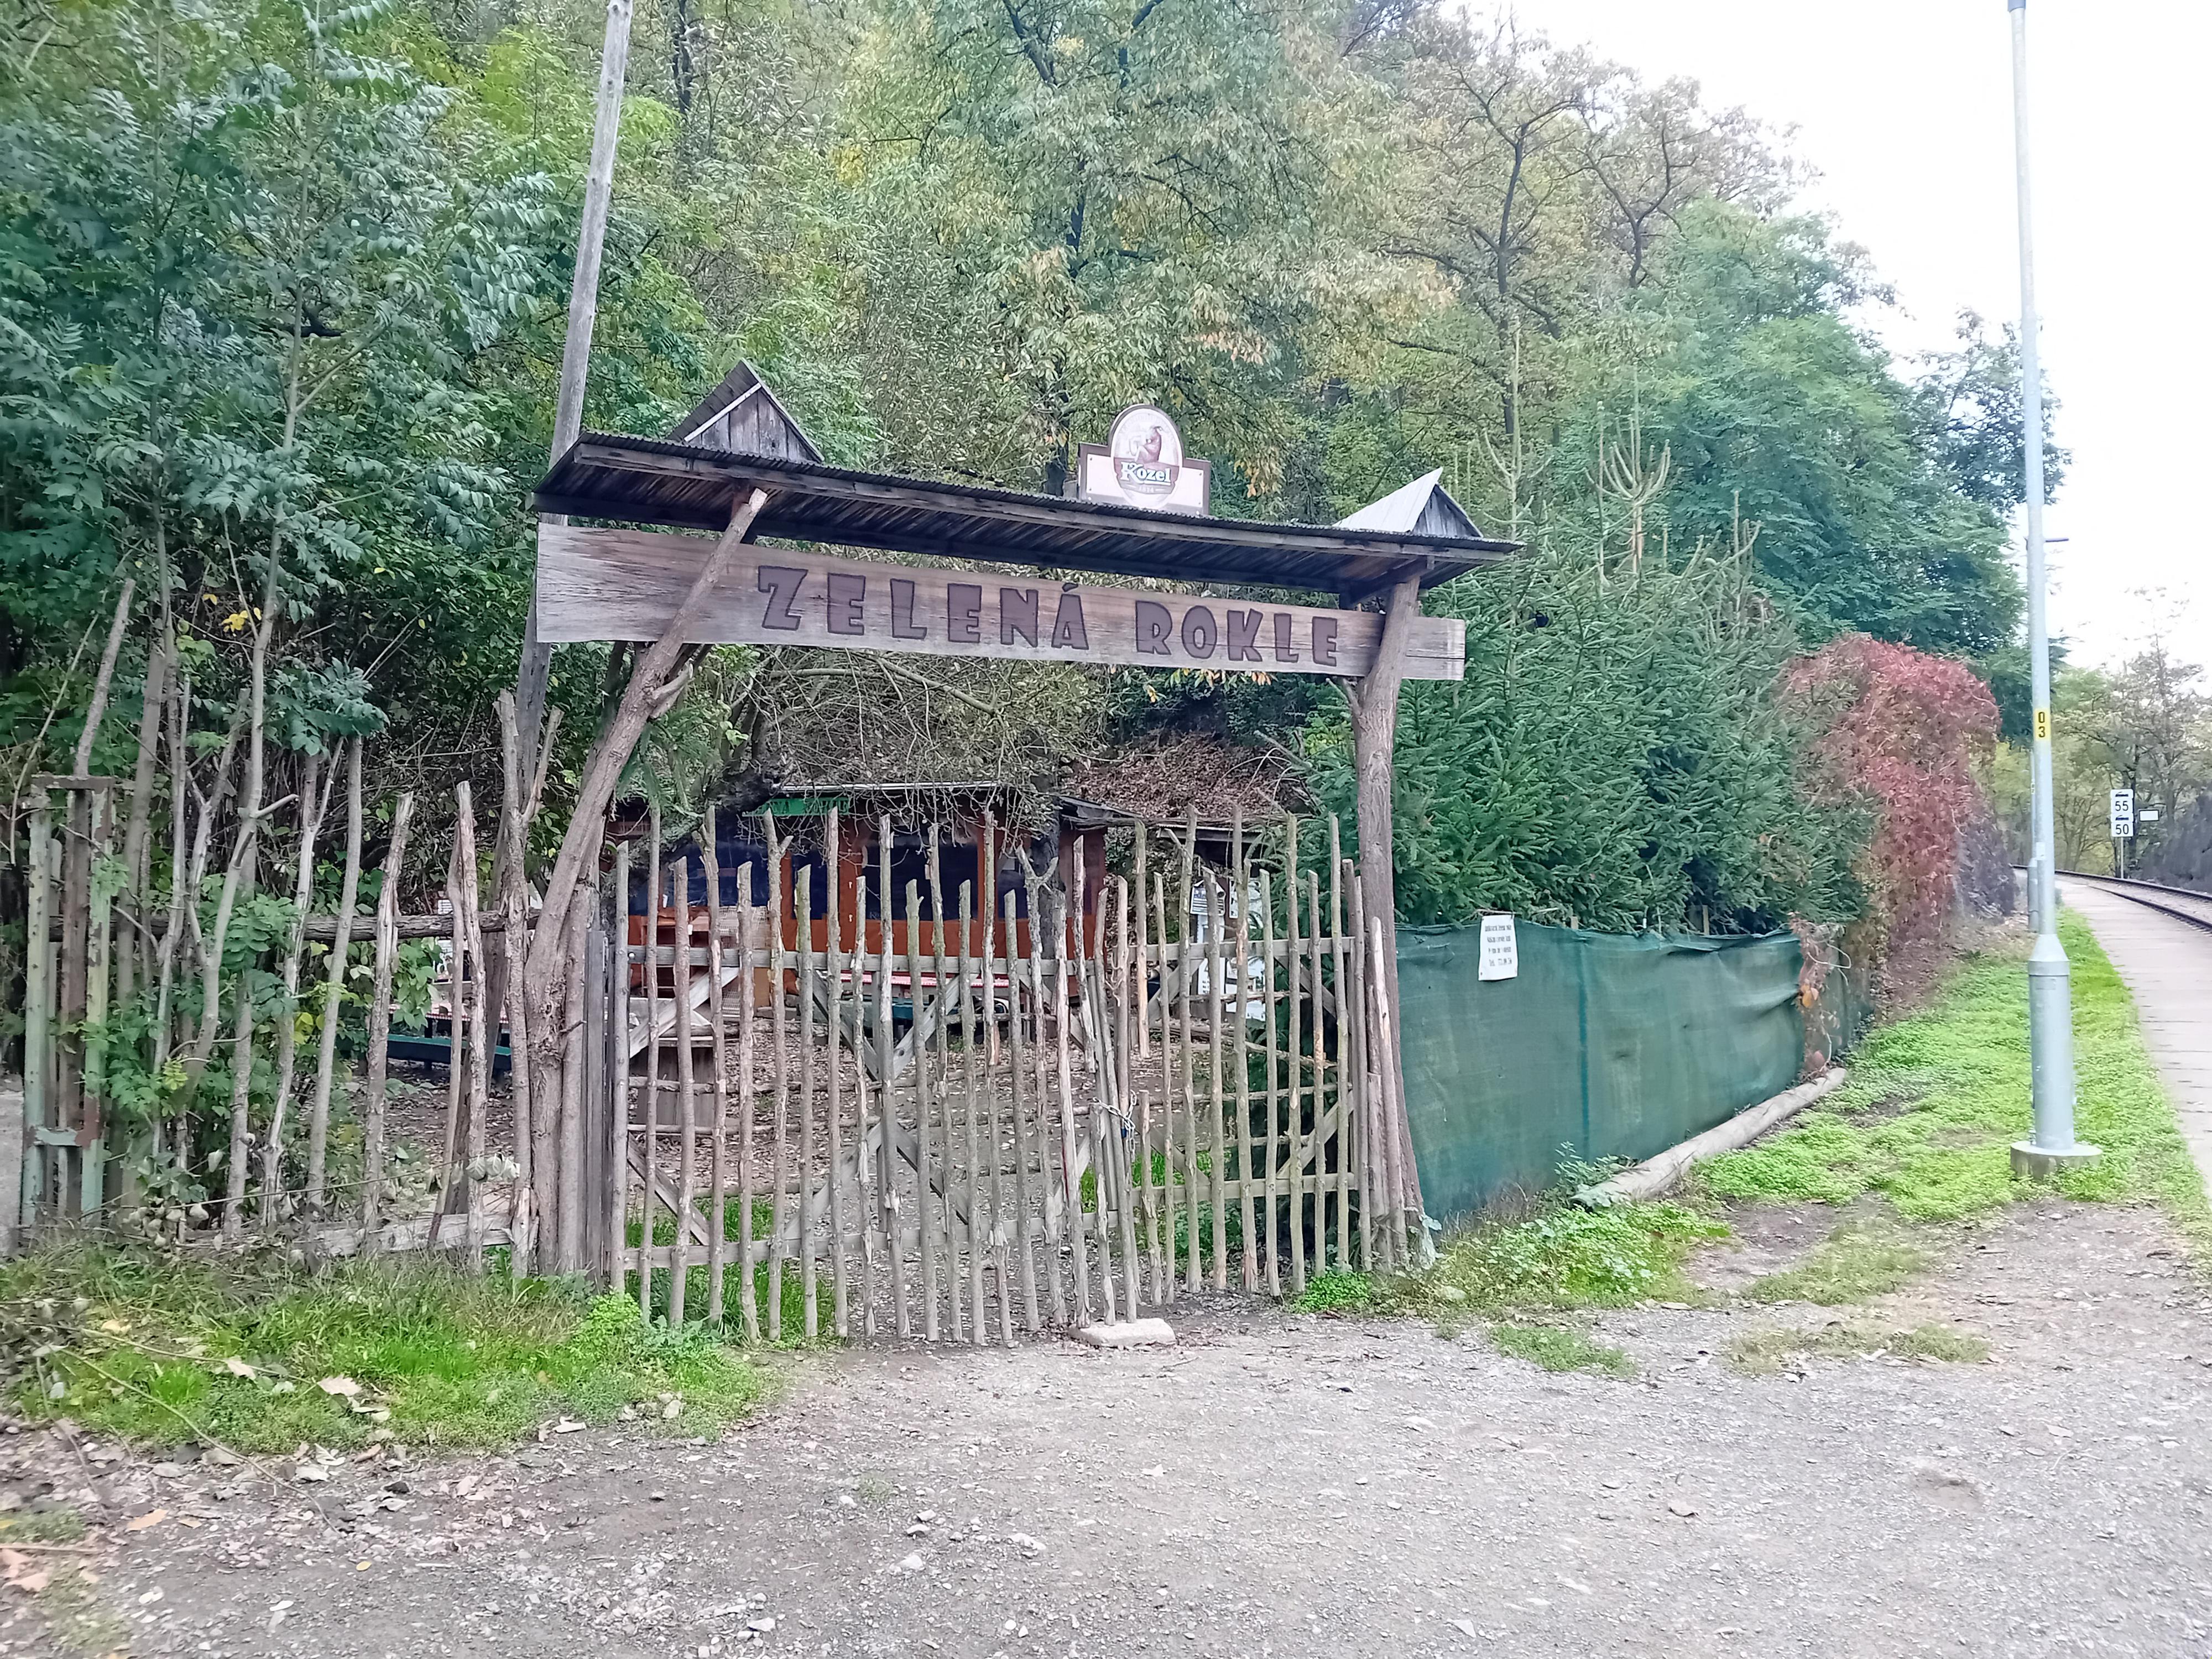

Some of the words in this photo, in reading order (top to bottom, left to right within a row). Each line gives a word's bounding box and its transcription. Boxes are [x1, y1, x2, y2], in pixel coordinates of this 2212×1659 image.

[1120, 461, 1171, 485] Kozel
[758, 565, 1089, 650] ZELENÁ
[1135, 600, 1338, 667] ROKLE
[2115, 800, 2128, 811] 55
[2116, 824, 2128, 834] 50
